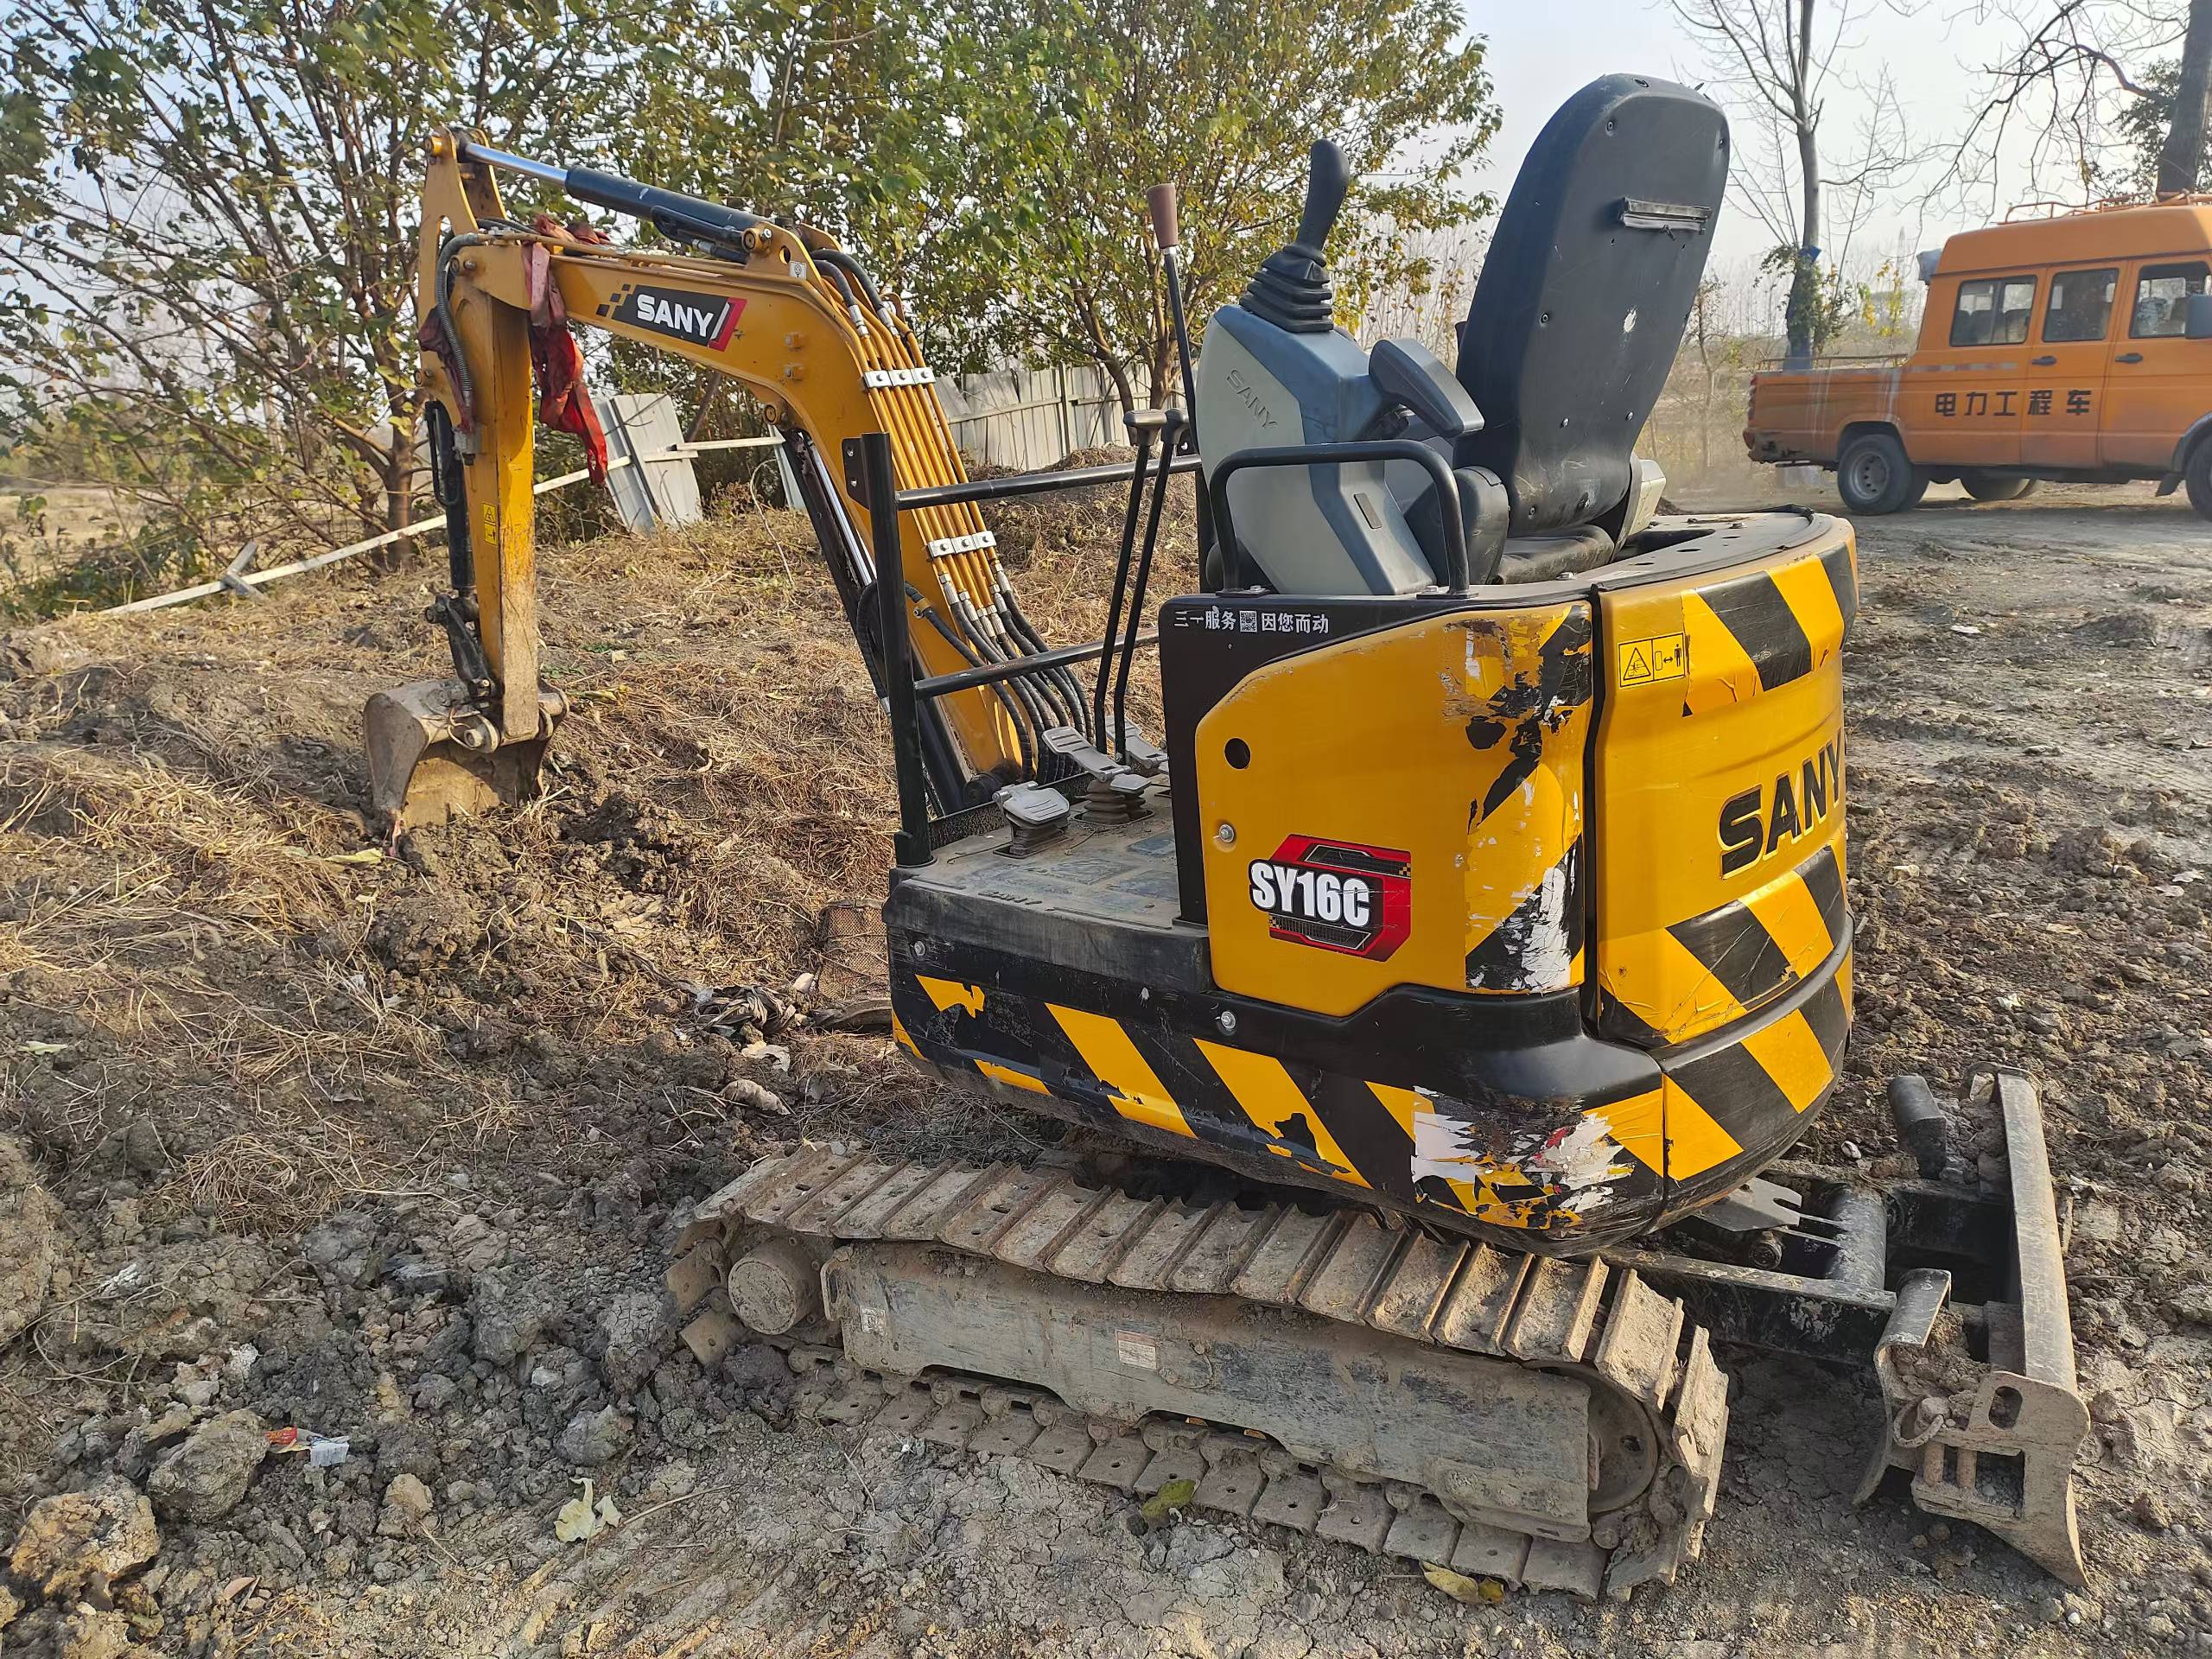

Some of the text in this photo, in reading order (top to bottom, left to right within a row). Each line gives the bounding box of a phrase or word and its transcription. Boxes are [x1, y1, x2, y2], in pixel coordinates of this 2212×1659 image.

[637, 294, 714, 337] SANY
[1226, 369, 1278, 429] SANY
[1935, 389, 2092, 416] 电力工程车
[1173, 607, 1329, 634] 三一服务 因您而动
[1718, 728, 1842, 879] SANY
[1250, 861, 1370, 928] SY16C
